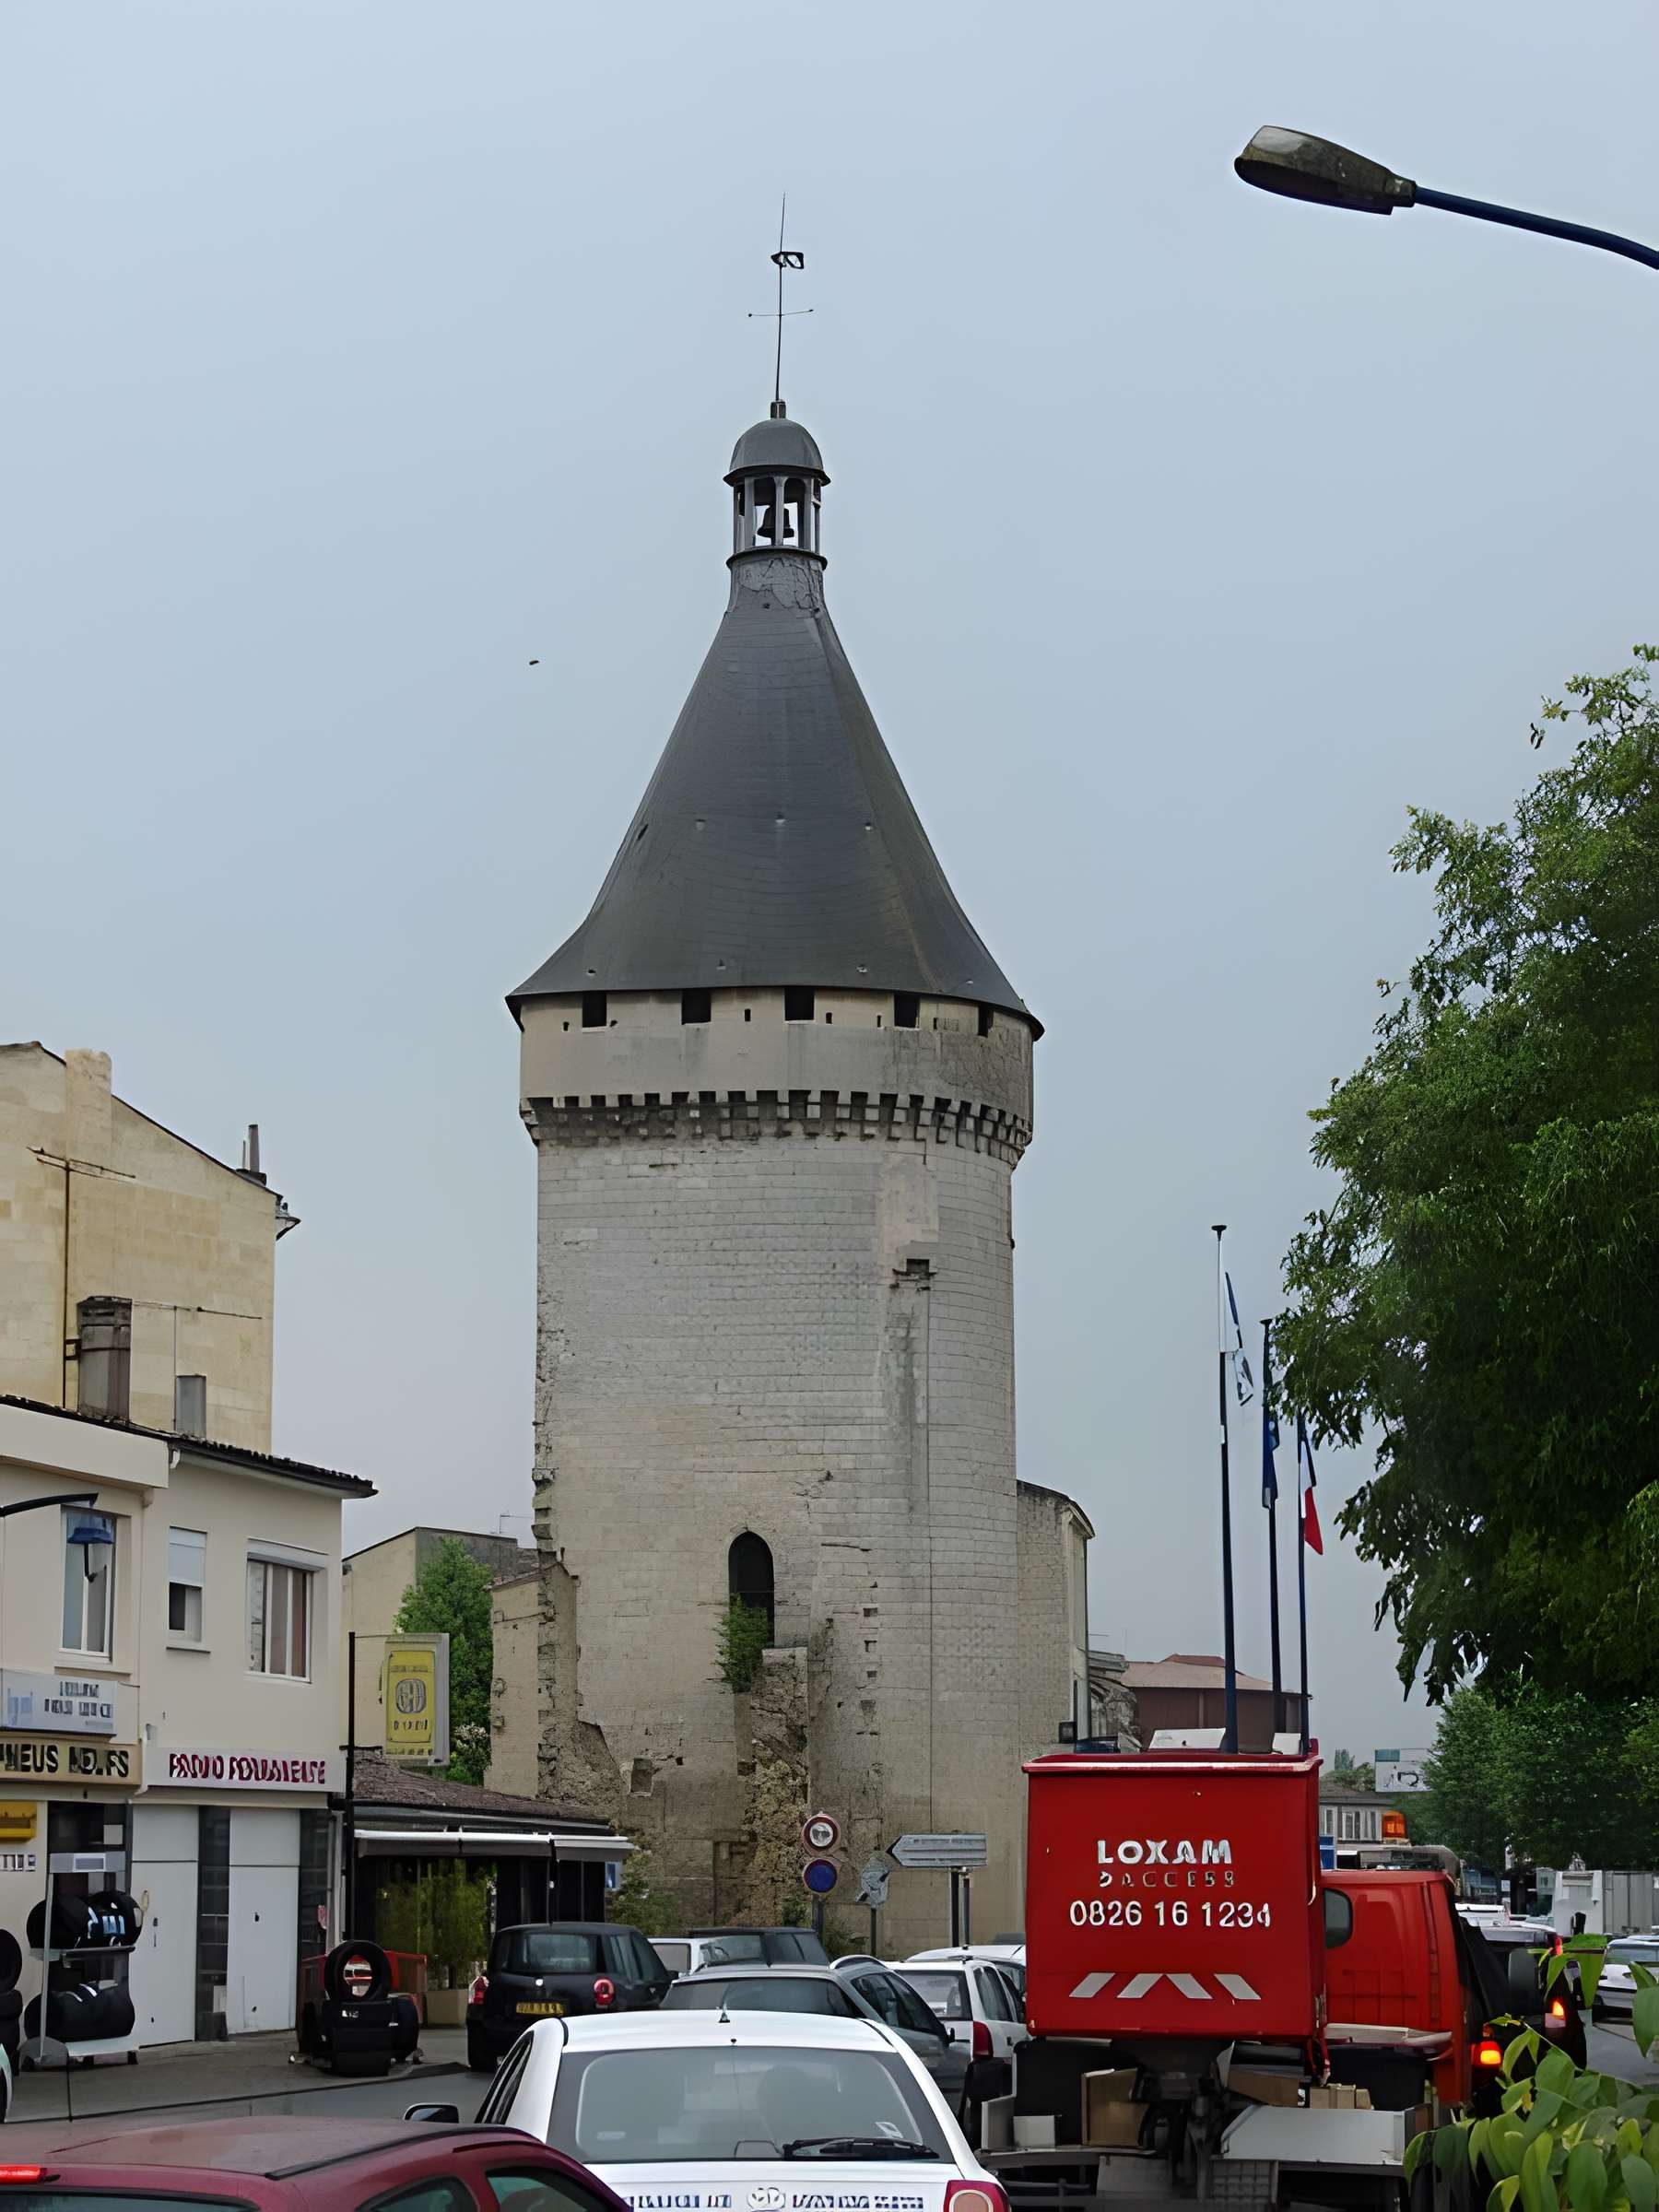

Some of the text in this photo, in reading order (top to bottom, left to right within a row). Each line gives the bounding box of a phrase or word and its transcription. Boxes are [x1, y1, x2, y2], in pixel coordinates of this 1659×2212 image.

[1097, 1840, 1232, 1865] LOXAM
[1069, 1900, 1271, 1928] 0826 16 1234
